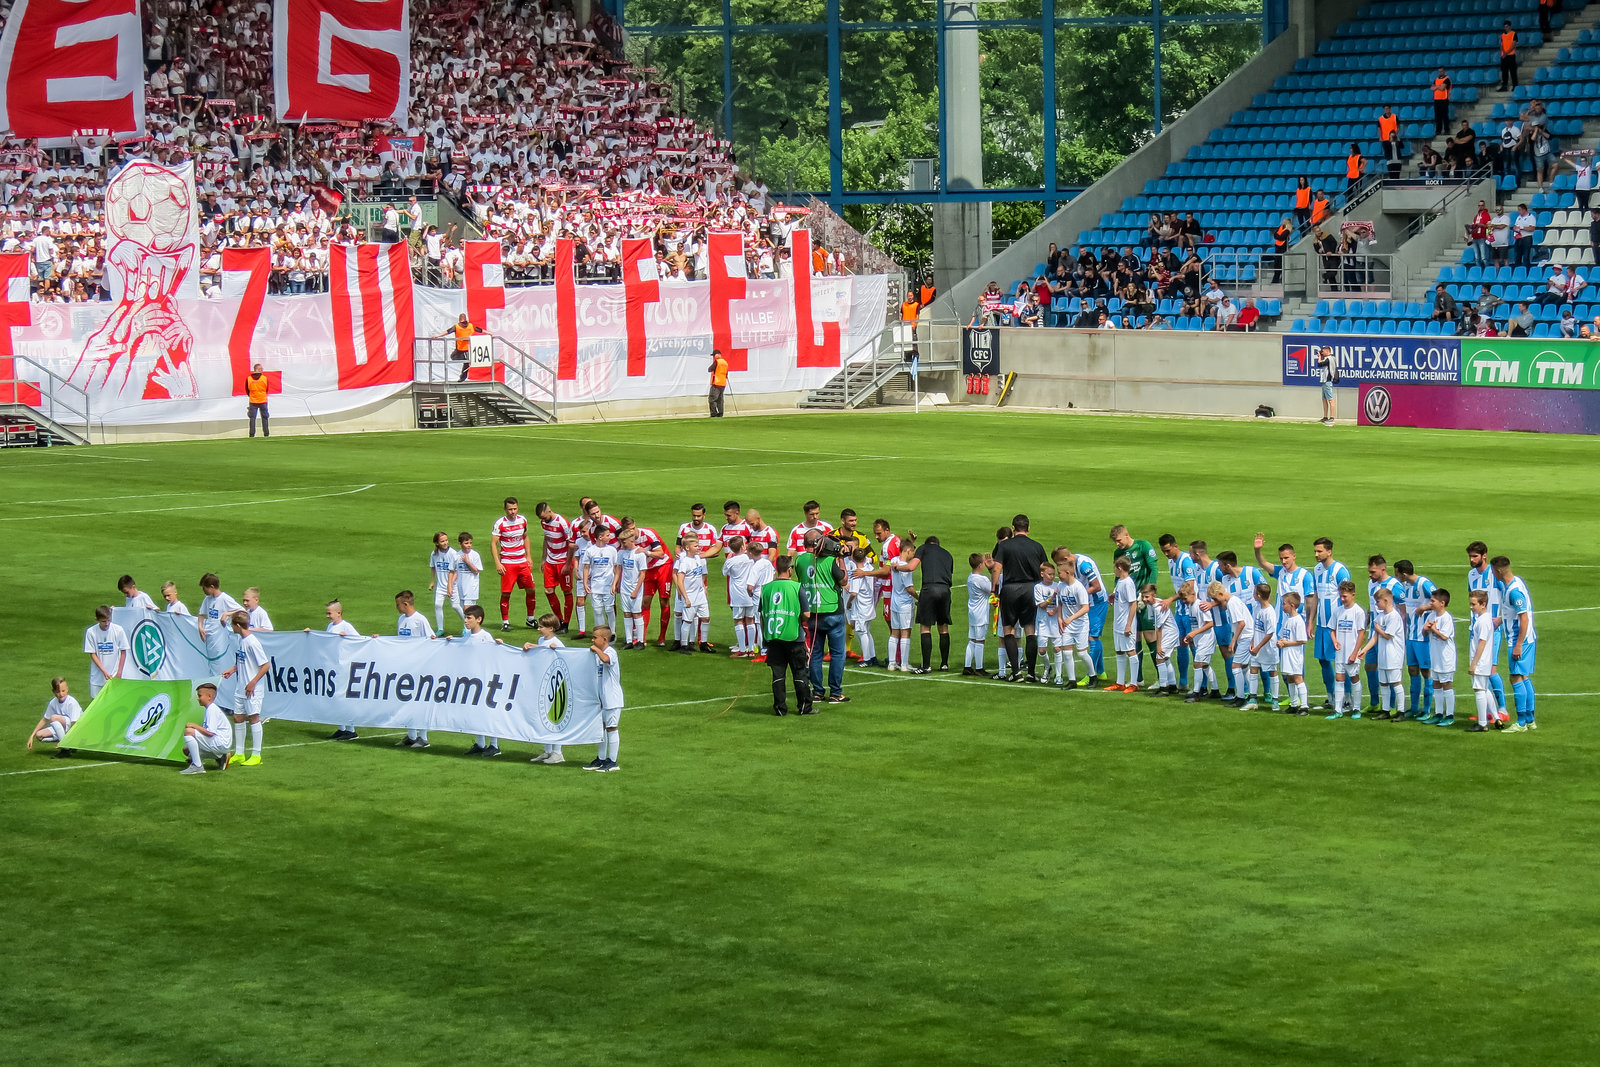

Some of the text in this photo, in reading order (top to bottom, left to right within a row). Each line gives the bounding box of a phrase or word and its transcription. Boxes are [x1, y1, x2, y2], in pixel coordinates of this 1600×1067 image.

[735, 311, 776, 325] HALBE
[740, 330, 776, 344] LITER
[472, 345, 491, 363] 19A
[973, 350, 989, 359] CFC
[1338, 369, 1408, 380] TALDRUCK-PARTNER
[1410, 371, 1418, 380] IN
[1420, 371, 1457, 382] CHEMNITZ
[1472, 360, 1520, 383] TTM
[1535, 361, 1584, 385] TTM
[303, 666, 337, 698] ans
[345, 661, 520, 712] Ehrenamt!
